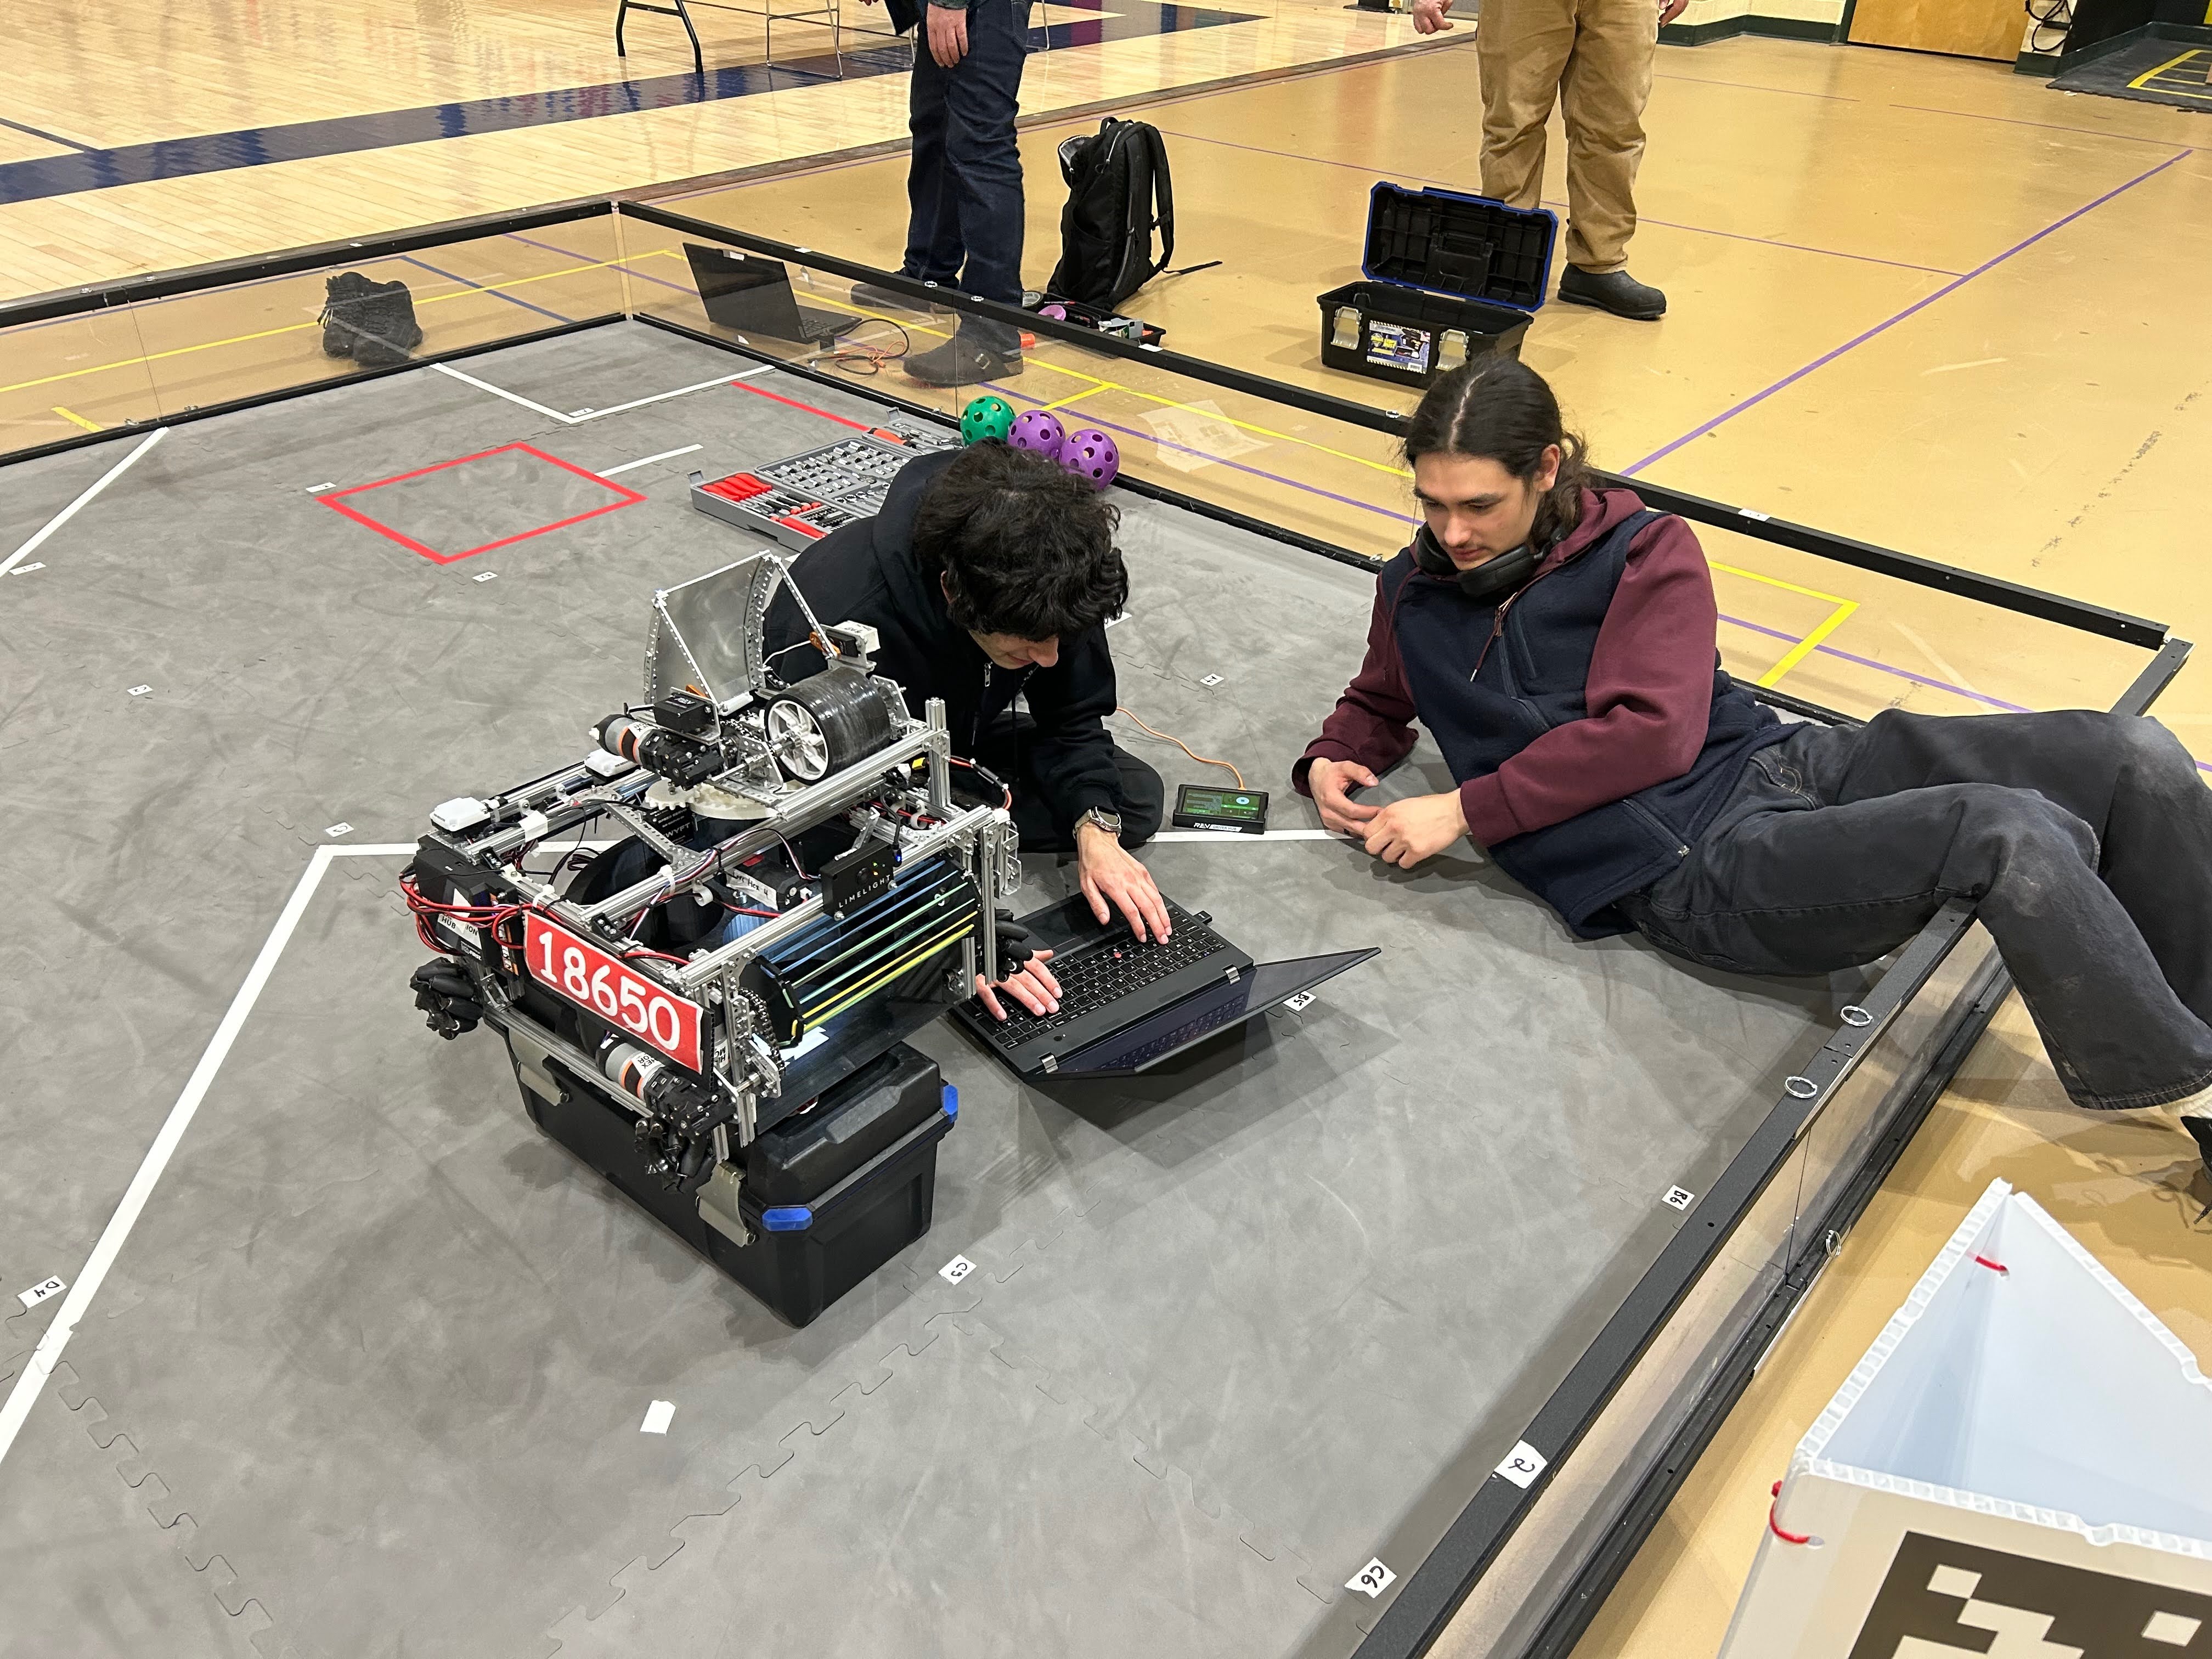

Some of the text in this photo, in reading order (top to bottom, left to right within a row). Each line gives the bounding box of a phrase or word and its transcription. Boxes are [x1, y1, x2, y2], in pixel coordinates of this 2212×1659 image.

[663, 822, 690, 838] WYFT
[764, 889, 769, 900] 4
[839, 874, 890, 908] LIMELIGHT
[441, 916, 456, 929] HUB
[539, 931, 680, 1051] 18650
[1293, 993, 1310, 1006] B5
[1669, 1190, 1688, 1205] B6
[33, 1280, 60, 1297] D4
[1508, 1458, 1535, 1472] 2
[1361, 1565, 1385, 1589] C6
